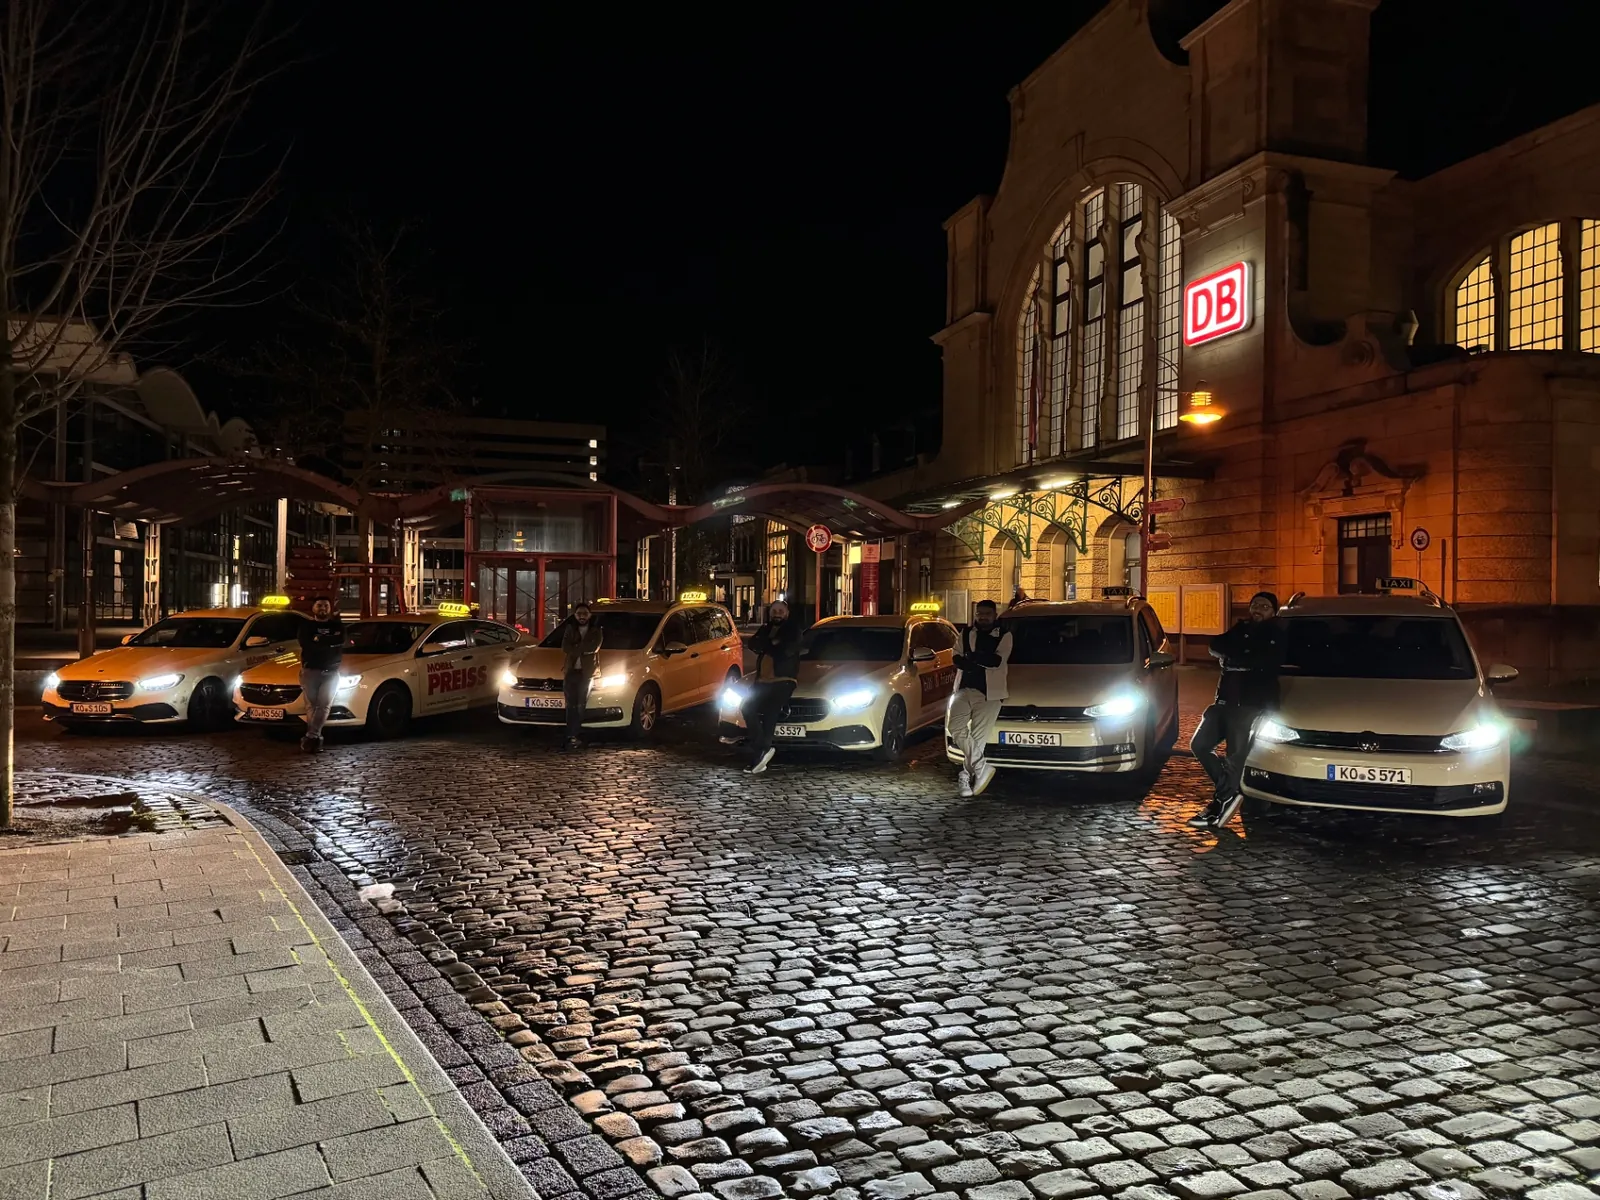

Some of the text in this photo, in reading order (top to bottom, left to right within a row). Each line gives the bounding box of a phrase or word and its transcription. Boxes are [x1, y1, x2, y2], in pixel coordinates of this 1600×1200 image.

[1192, 278, 1238, 333] DB
[1384, 580, 1411, 588] TAXI
[428, 665, 487, 696] PREISS
[787, 726, 802, 736] 537
[1008, 733, 1022, 744] KO
[1037, 734, 1056, 745] 561
[1340, 767, 1358, 780] KO
[1379, 769, 1405, 783] 571
